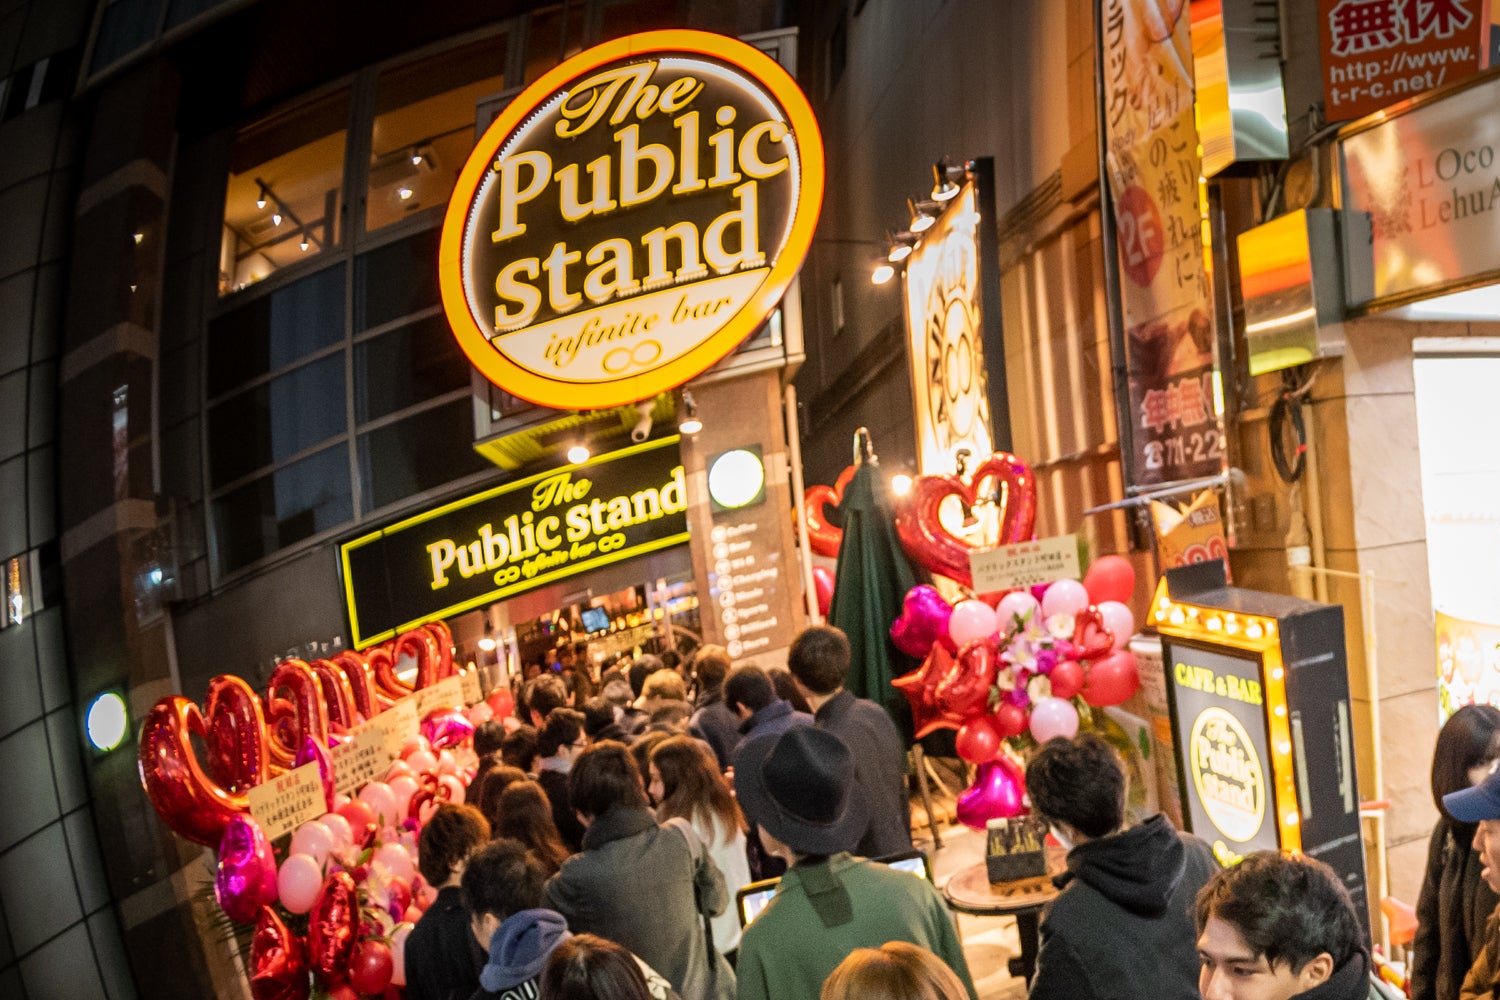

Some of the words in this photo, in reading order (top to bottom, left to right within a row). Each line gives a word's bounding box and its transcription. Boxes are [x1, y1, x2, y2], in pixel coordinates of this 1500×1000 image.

[555, 61, 705, 139] The
[1105, 0, 1127, 129] ラック
[491, 104, 793, 243] Public
[1116, 207, 1156, 267] 2F
[544, 312, 659, 369] infinite
[671, 294, 733, 325] bar
[531, 471, 593, 512] The
[426, 510, 562, 591] Public
[1174, 662, 1215, 694] CAFE
[1226, 674, 1263, 705] BAR
[1198, 735, 1258, 786] Public
